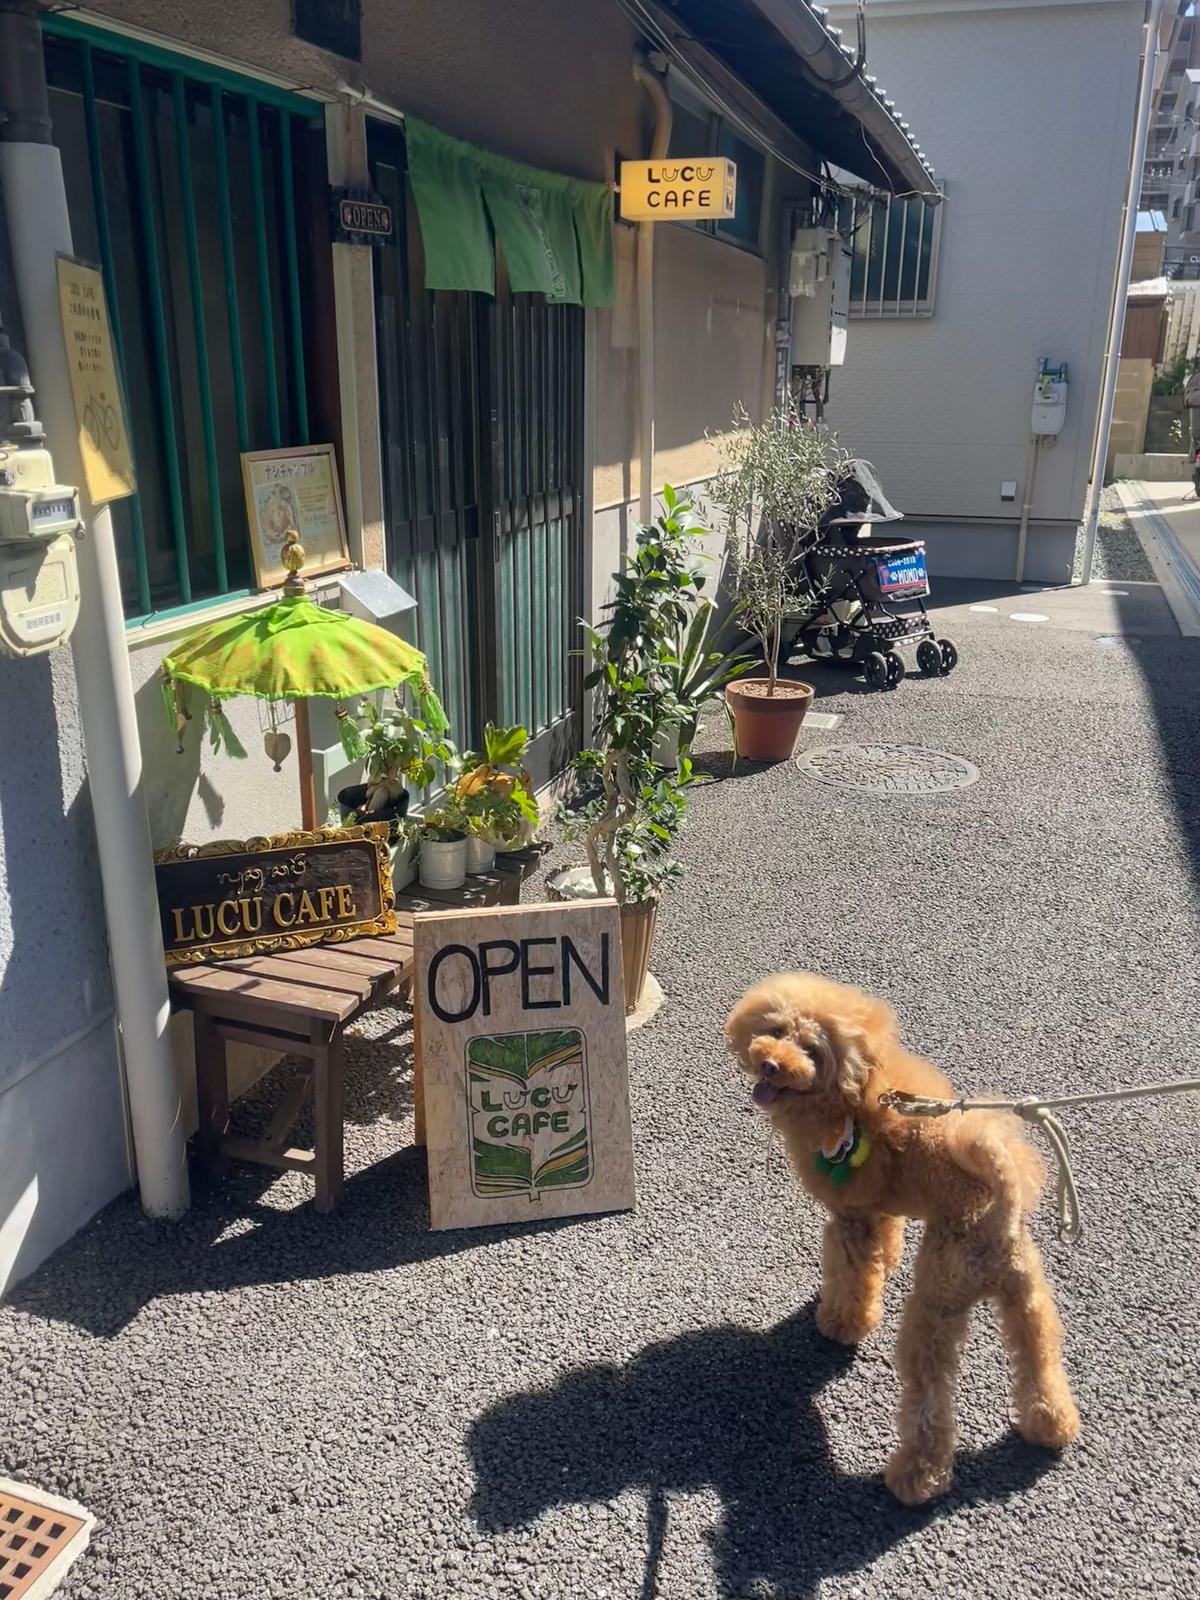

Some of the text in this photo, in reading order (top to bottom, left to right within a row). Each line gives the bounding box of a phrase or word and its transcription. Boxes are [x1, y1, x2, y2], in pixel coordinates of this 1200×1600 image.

[647, 166, 715, 184] LUCU
[647, 189, 711, 208] CAFE
[352, 206, 382, 229] OPEN
[897, 568, 919, 585] MOMO
[171, 884, 357, 943] LUCU CAFE
[427, 932, 610, 1024] OPEN
[480, 1083, 578, 1113] LUCU
[486, 1110, 570, 1138] CAFE
